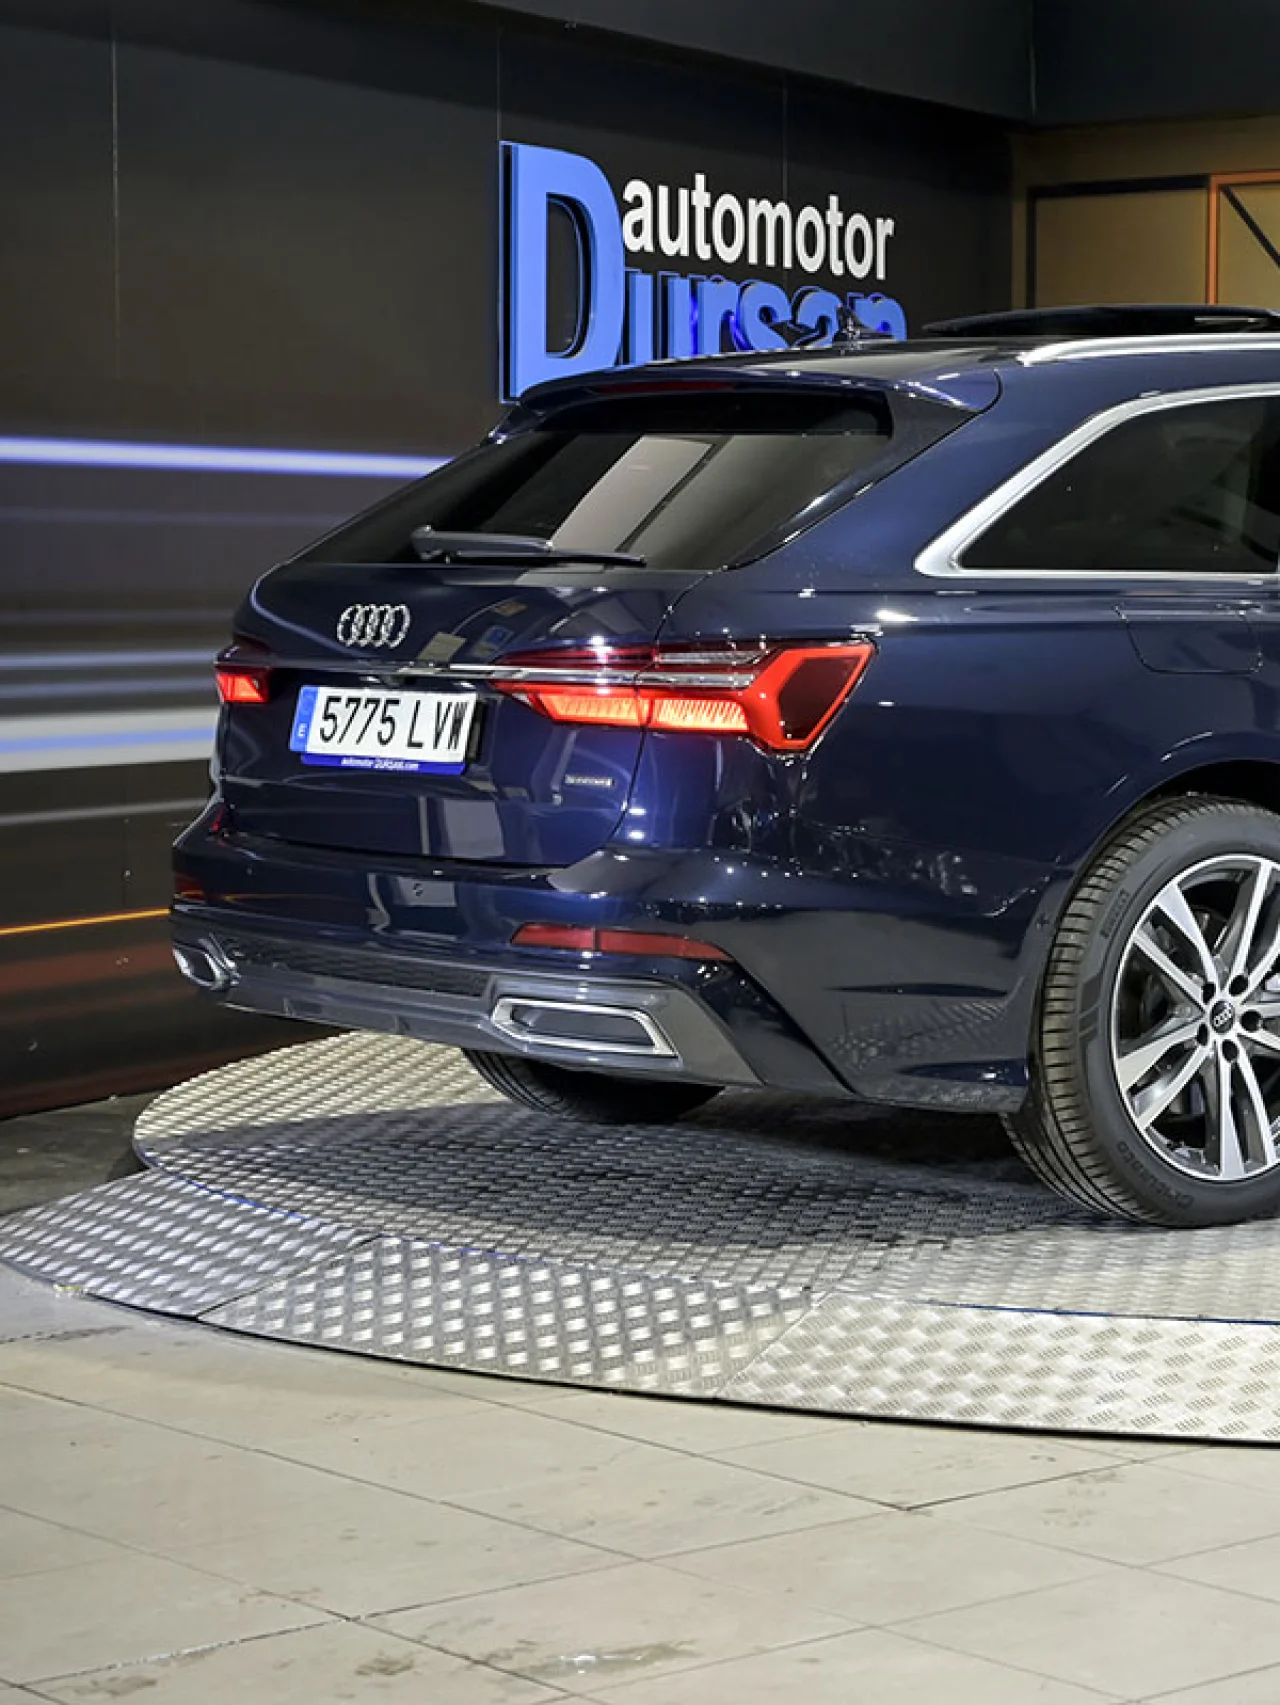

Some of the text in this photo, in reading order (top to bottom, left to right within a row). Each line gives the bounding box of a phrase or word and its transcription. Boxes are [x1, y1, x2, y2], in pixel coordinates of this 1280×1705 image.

[621, 172, 895, 281] automotor
[319, 695, 469, 750] 5775 LVW
